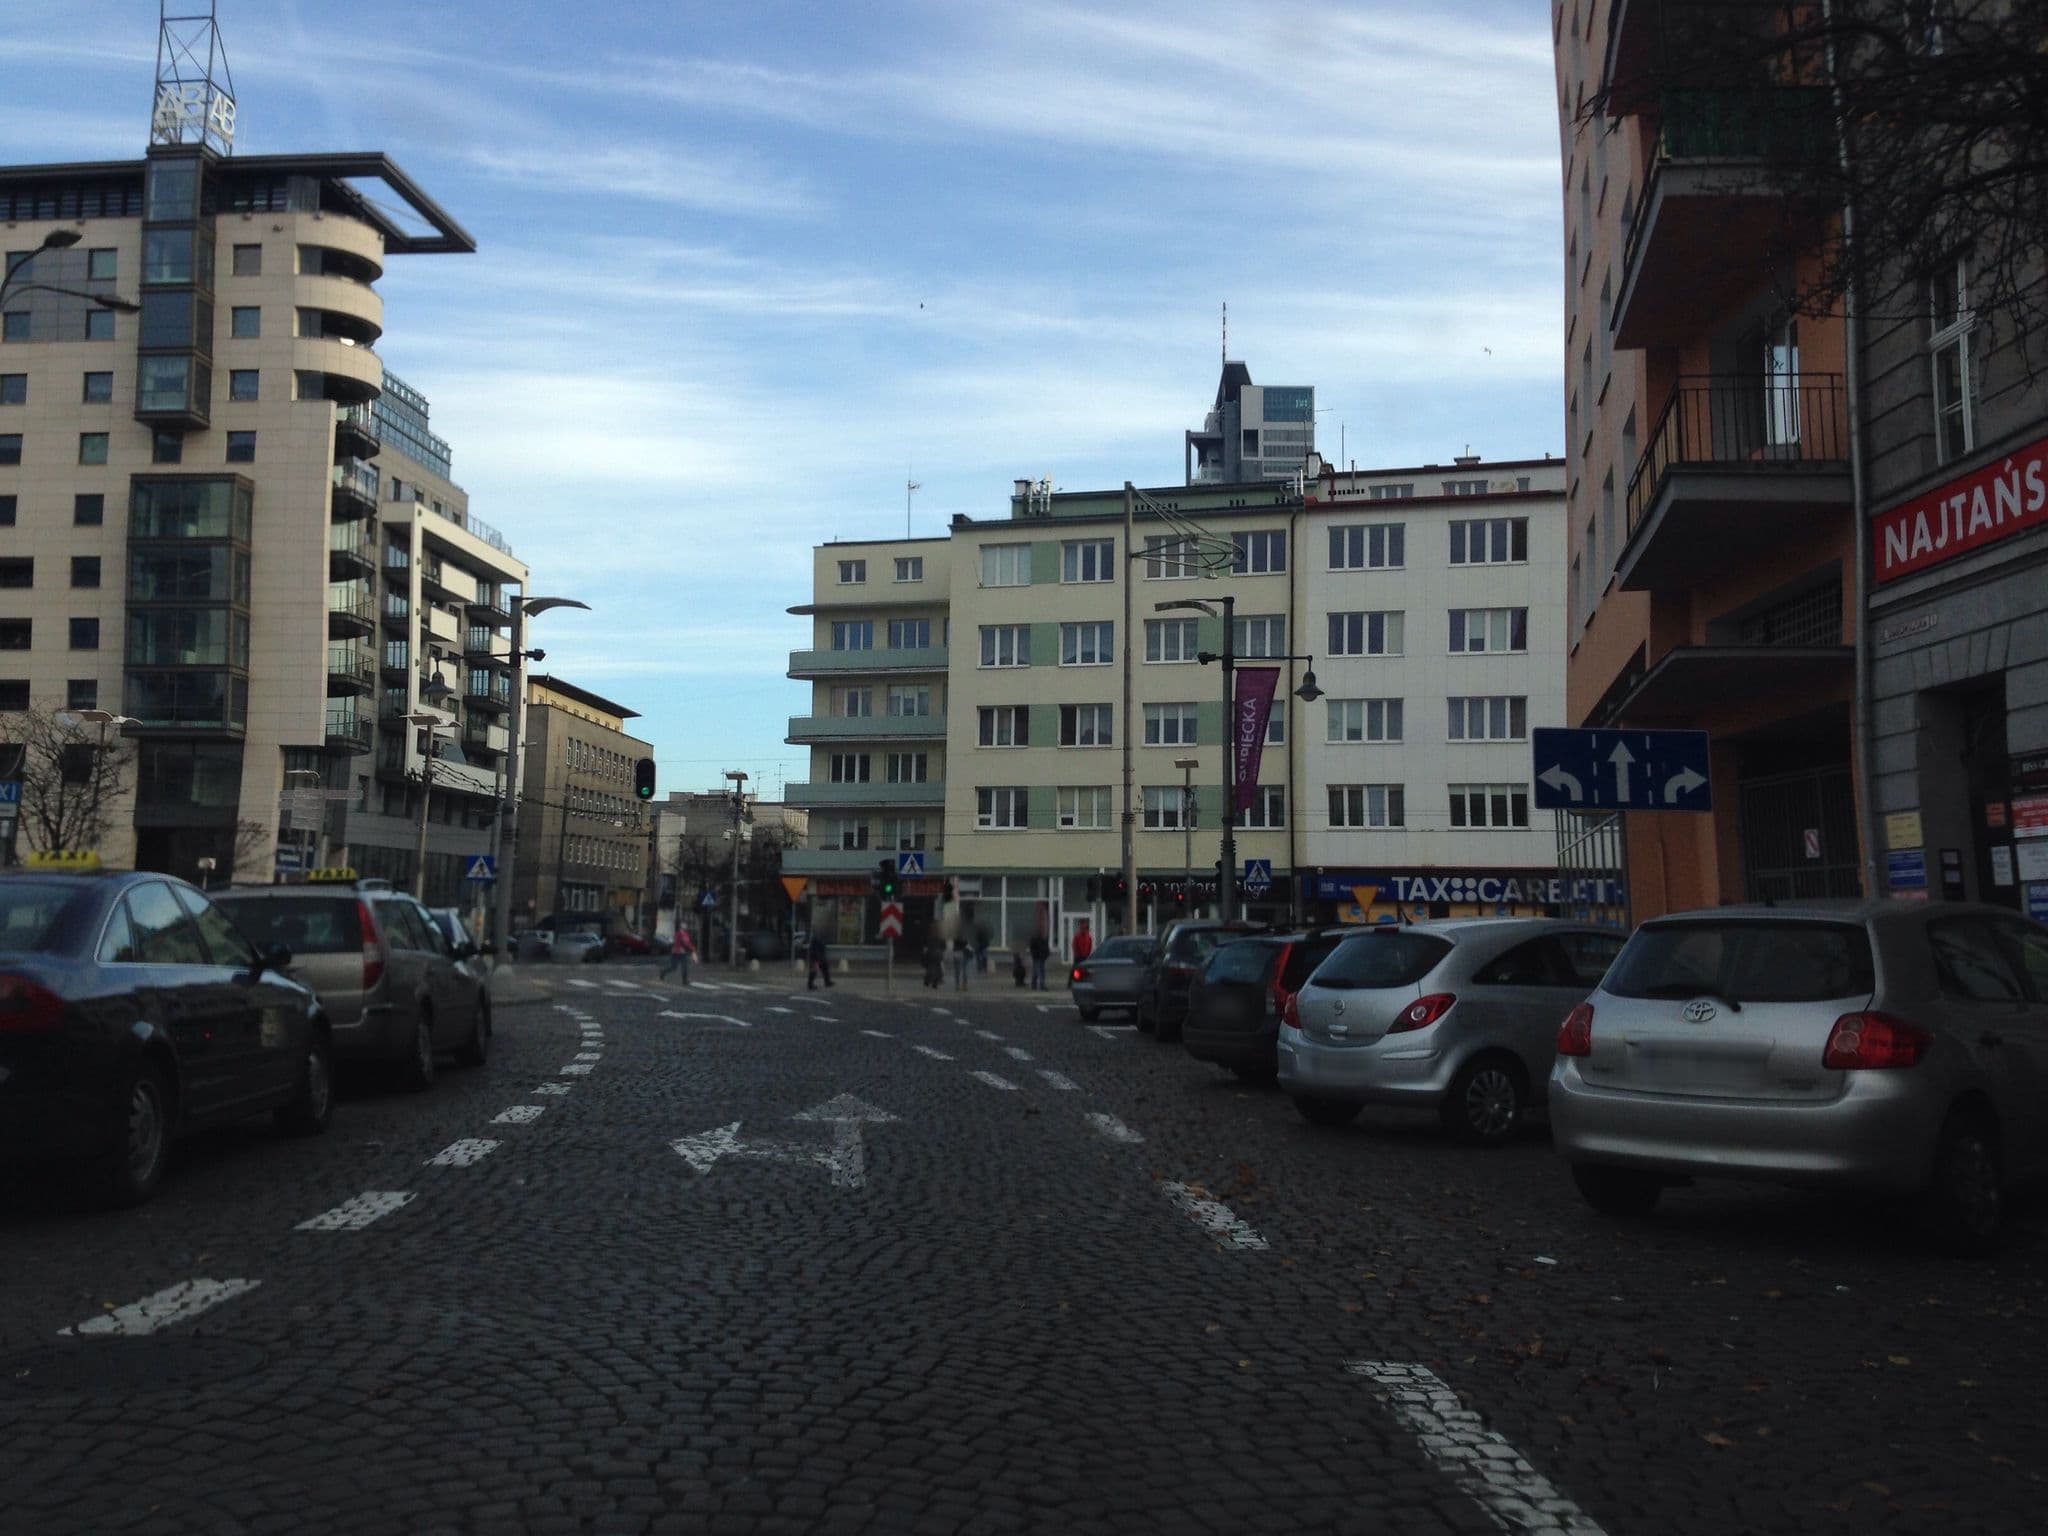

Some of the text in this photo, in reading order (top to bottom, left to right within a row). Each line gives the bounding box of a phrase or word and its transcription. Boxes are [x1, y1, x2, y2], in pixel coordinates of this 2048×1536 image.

[210, 93, 236, 135] AB
[1884, 458, 2046, 569] NAJTAŃS
[314, 868, 351, 878] TAXI
[1391, 876, 1451, 902] TAX
